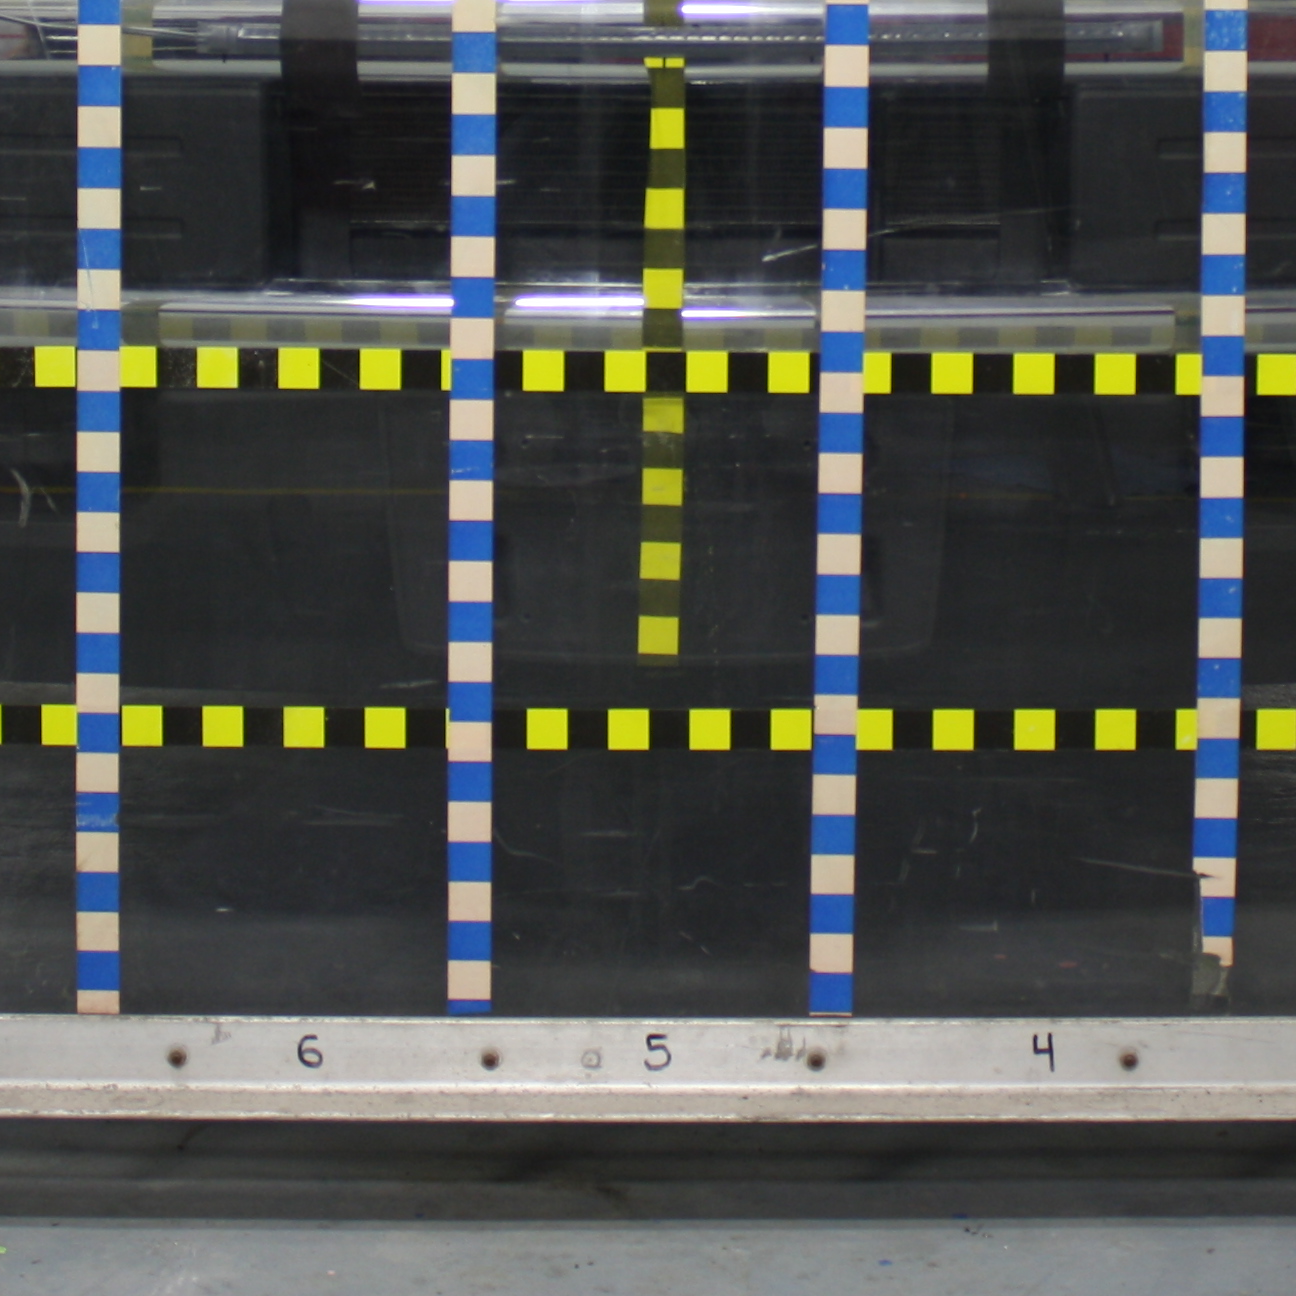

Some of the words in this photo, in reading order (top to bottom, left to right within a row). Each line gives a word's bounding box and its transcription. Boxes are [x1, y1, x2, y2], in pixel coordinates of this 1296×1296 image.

[296, 1033, 324, 1069] 6
[644, 1033, 673, 1072] 5
[1031, 1032, 1056, 1074] 4
